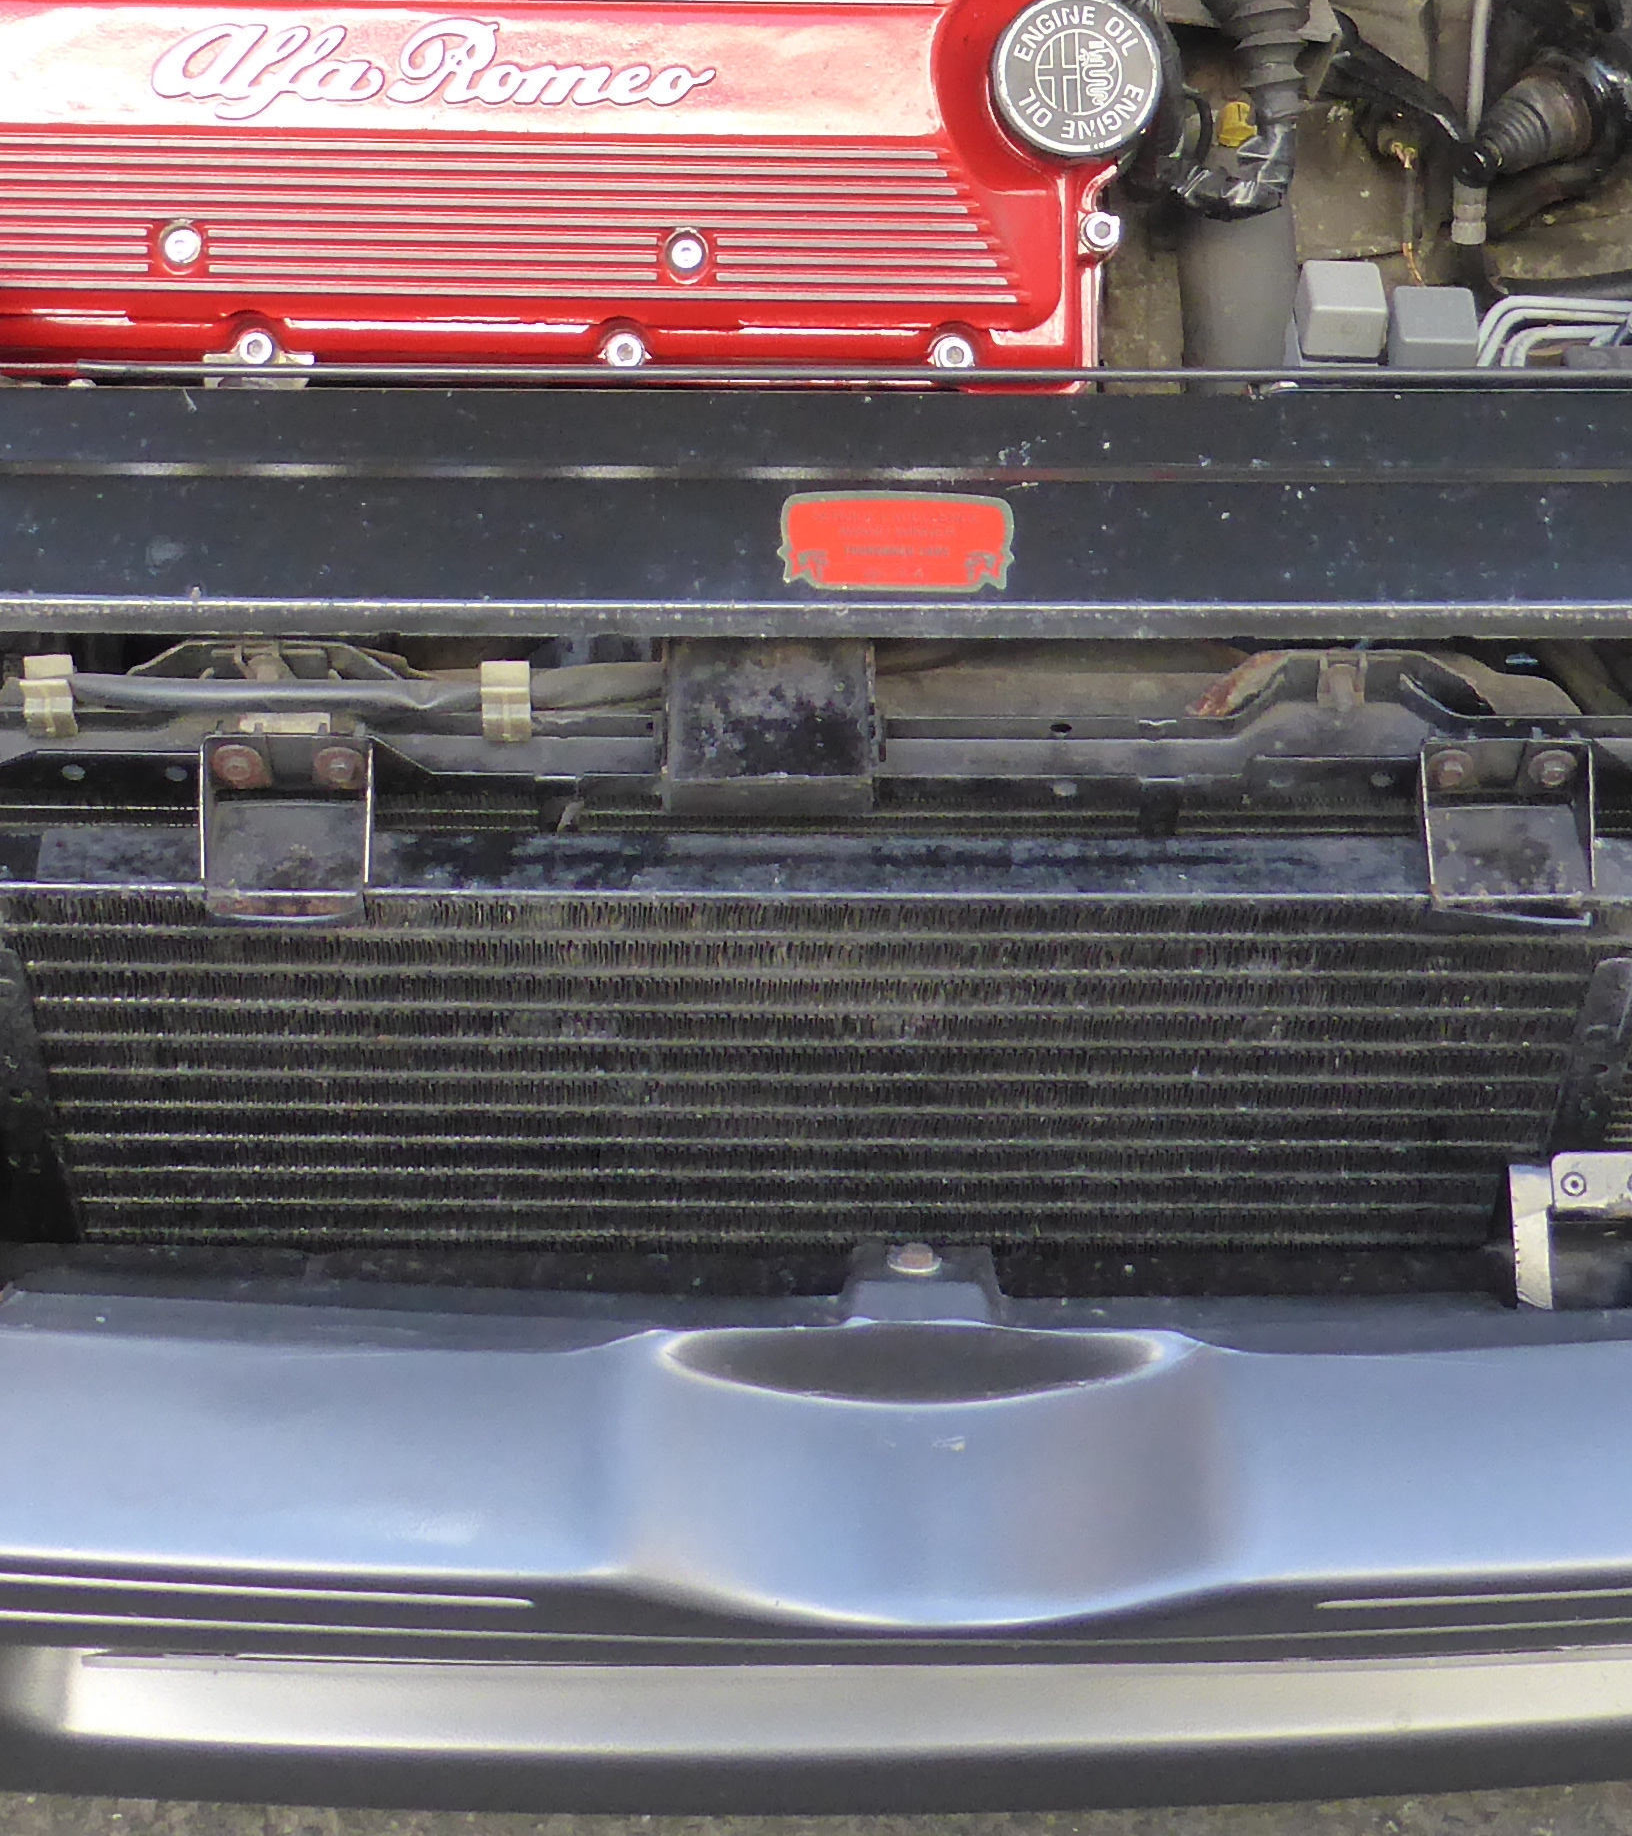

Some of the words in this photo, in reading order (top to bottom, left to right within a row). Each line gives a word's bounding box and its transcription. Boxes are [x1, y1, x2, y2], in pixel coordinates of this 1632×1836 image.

[1013, 4, 1096, 63] ENGINE
[1104, 15, 1140, 57] OIL
[151, 22, 386, 121] Alfa
[385, 16, 716, 106] Romeo
[1018, 87, 1054, 129] OIL
[1060, 82, 1145, 140] ENGINE
